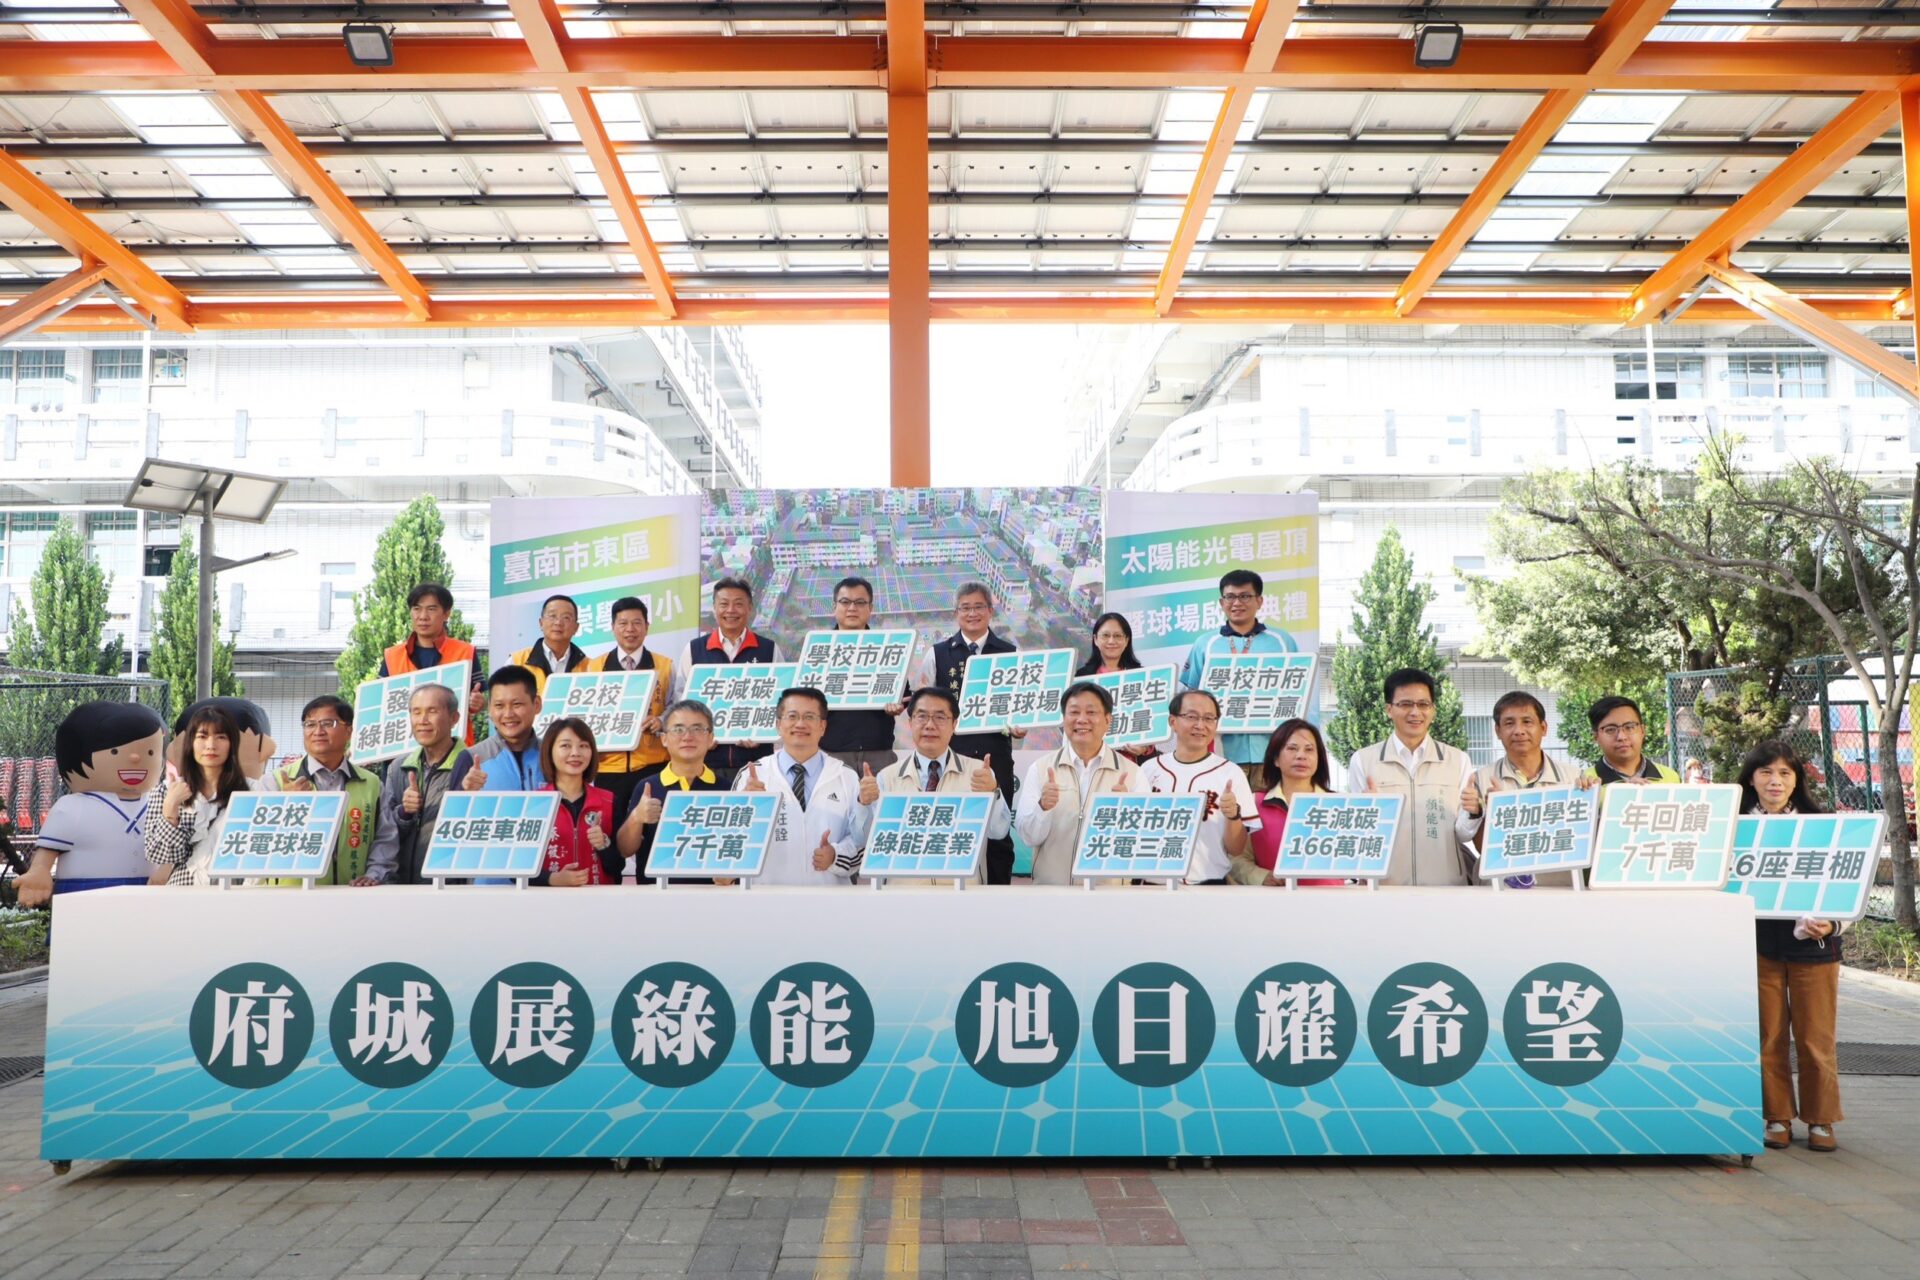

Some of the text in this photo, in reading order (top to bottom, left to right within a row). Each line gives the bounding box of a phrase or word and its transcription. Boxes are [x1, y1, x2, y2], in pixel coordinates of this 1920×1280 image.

[503, 529, 651, 586] 臺南市東區
[1121, 528, 1308, 577] 太陽能光電屋頂
[1125, 592, 1308, 639] 暨球場啟典禮
[806, 644, 906, 667] 學校市府
[800, 672, 898, 696] 光電三贏
[990, 663, 1044, 686] 82校
[1207, 667, 1307, 690] 學校市府
[568, 684, 622, 707] 82校
[701, 678, 776, 700] 年減碳
[963, 689, 1060, 719] 光電球場
[1217, 696, 1300, 719] 電三贏
[357, 719, 412, 750] 綠能
[537, 712, 635, 735] 光球場
[252, 802, 310, 828] 82校
[681, 805, 754, 828] 年回饋
[908, 804, 954, 828] 發展
[1092, 807, 1193, 831] 學校市府
[1304, 806, 1380, 829] 年減碳
[1495, 799, 1589, 828] 增加學生
[1622, 803, 1711, 833] 年回饋
[436, 818, 543, 842] 46座車棚
[221, 832, 324, 856] 光電球場
[676, 836, 748, 861] 7千萬
[874, 830, 976, 856] 綠能產業
[1086, 835, 1188, 859] 光電三贏
[1289, 834, 1384, 859] 166萬噸
[1503, 828, 1575, 857] 運動量
[1623, 841, 1697, 872] 7千萬
[1729, 850, 1866, 880] 6座車棚
[207, 979, 1605, 1067] 府城展綠能 旭日耀希望
